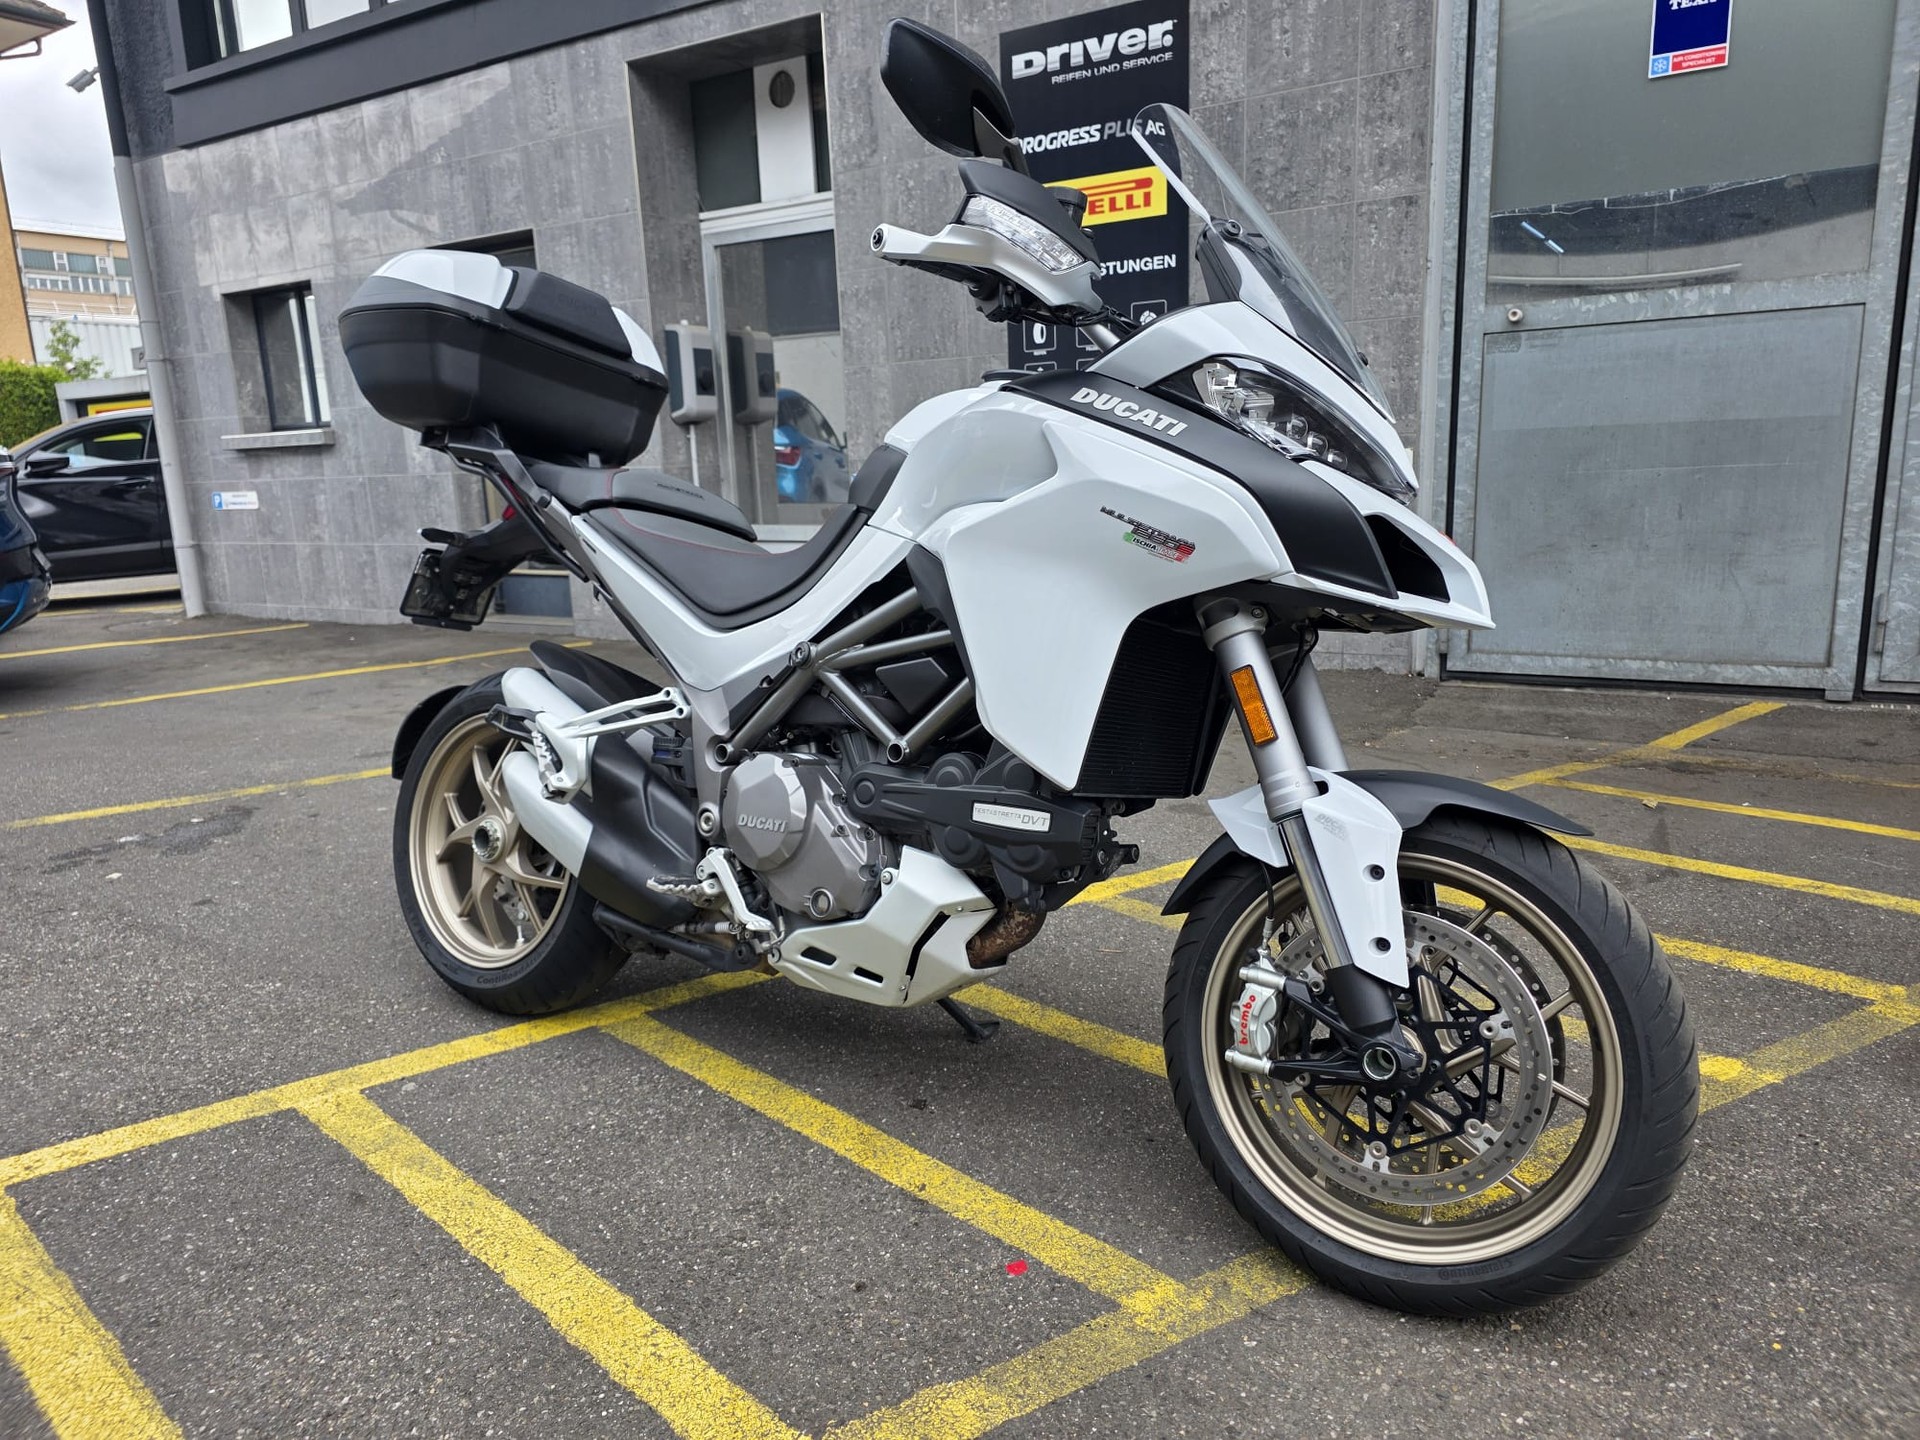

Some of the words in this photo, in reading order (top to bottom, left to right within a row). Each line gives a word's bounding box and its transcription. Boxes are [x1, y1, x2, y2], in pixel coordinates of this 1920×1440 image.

[1052, 69, 1092, 85] REIFEN
[1094, 62, 1120, 77] UND
[1122, 51, 1174, 70] SERVICE
[1018, 123, 1101, 155] ROGRESS
[1145, 119, 1166, 136] AG
[1082, 179, 1153, 215] ELLI
[1100, 254, 1177, 276] STUNGEN
[1070, 387, 1188, 437] DUCATI
[738, 814, 787, 833] DUCATI
[1021, 814, 1048, 827] DVT
[1238, 994, 1257, 1046] brembo
